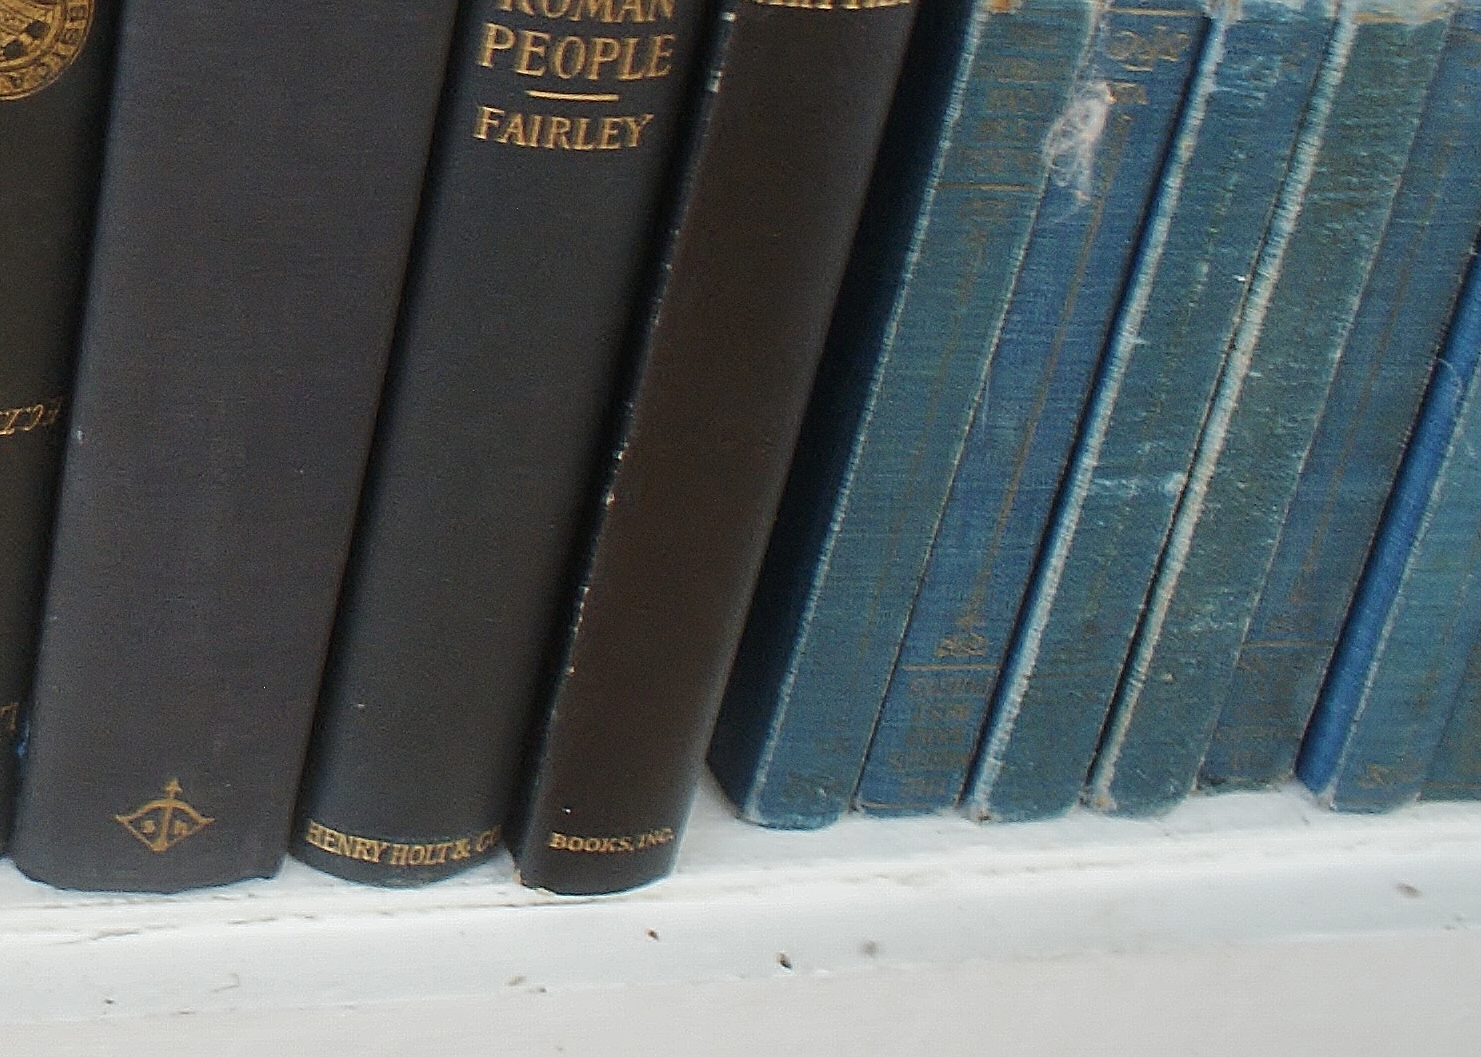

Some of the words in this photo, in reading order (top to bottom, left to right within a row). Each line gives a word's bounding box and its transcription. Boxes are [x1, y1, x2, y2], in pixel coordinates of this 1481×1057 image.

[476, 22, 676, 81] PEOPLE
[473, 105, 655, 151] FAIRLEY
[306, 819, 390, 863] HENRY
[389, 843, 451, 865] HOLT
